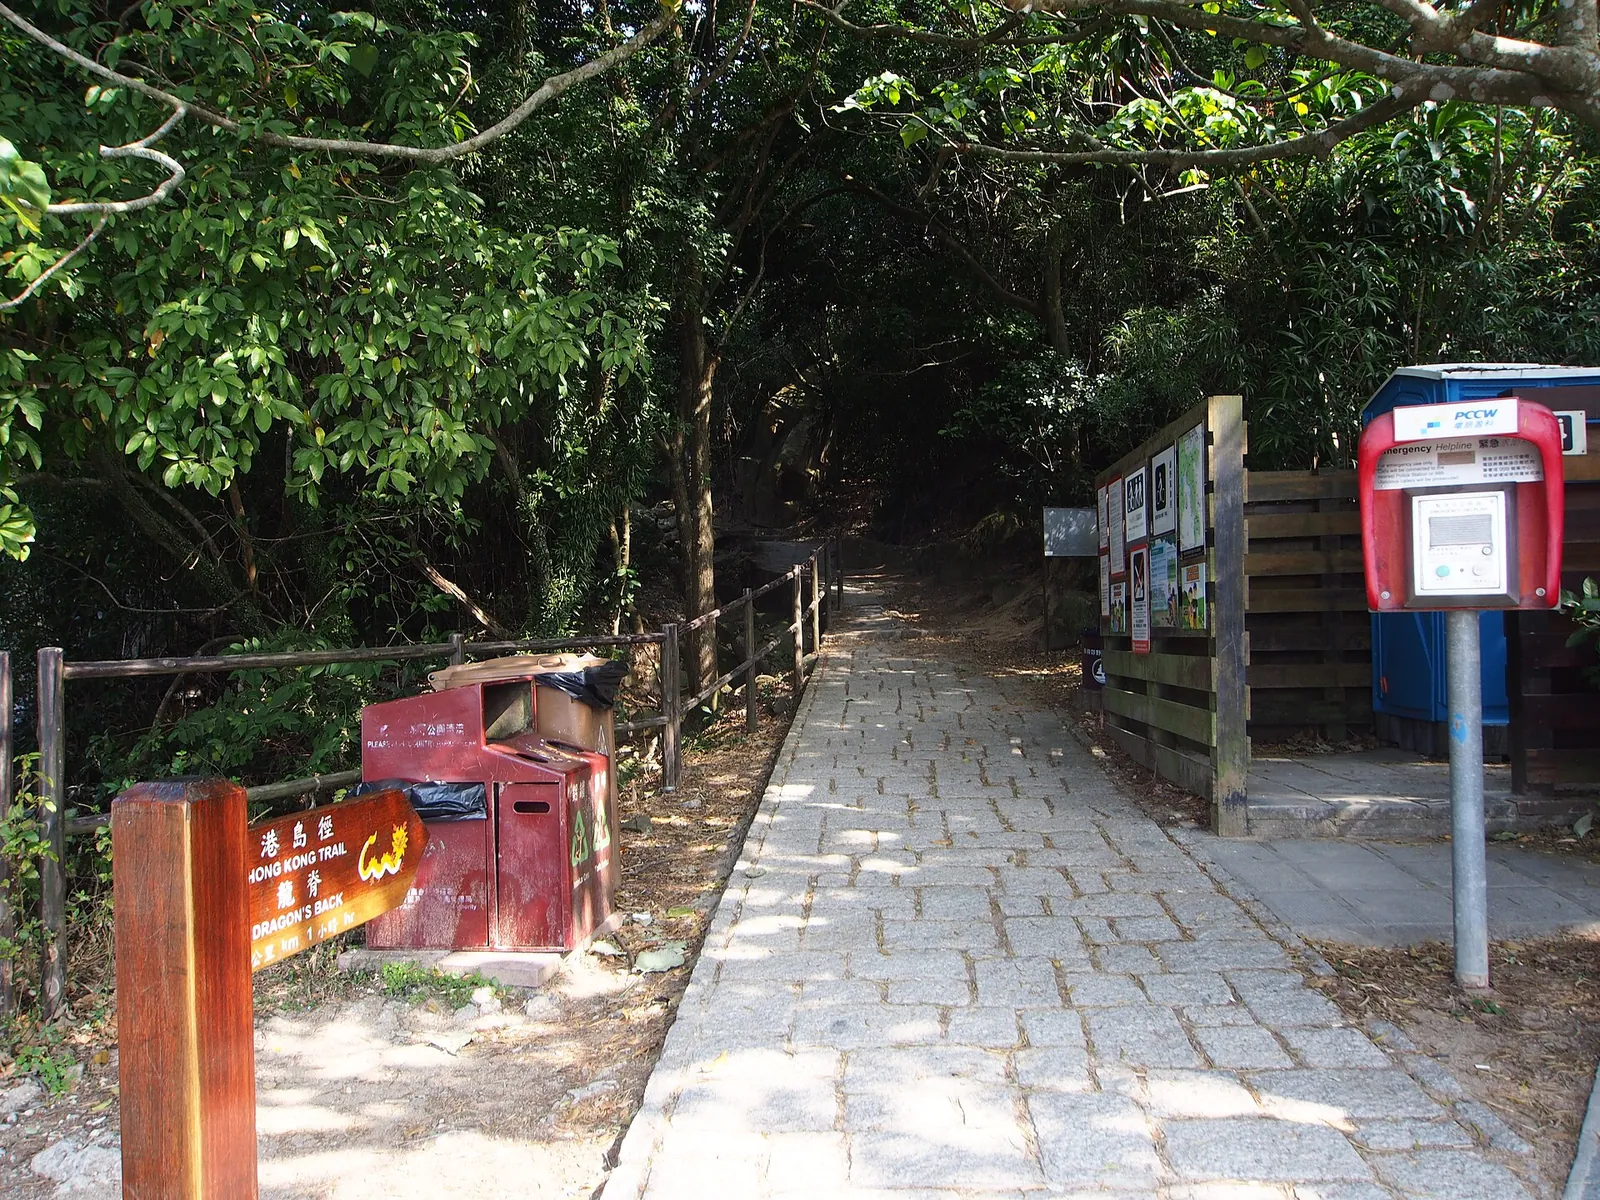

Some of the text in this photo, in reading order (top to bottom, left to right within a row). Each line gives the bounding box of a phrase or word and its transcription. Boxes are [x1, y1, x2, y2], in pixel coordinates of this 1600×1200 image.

[1455, 409, 1498, 420] PCCW
[1381, 441, 1472, 456] mergency Helpline
[261, 815, 334, 858] 港島徑
[249, 842, 348, 884] HONG KONG TRAIL
[277, 869, 323, 910] 龍脊
[252, 892, 344, 940] DRAGON'S BACK
[281, 934, 299, 952] km
[343, 910, 356, 926] hr
